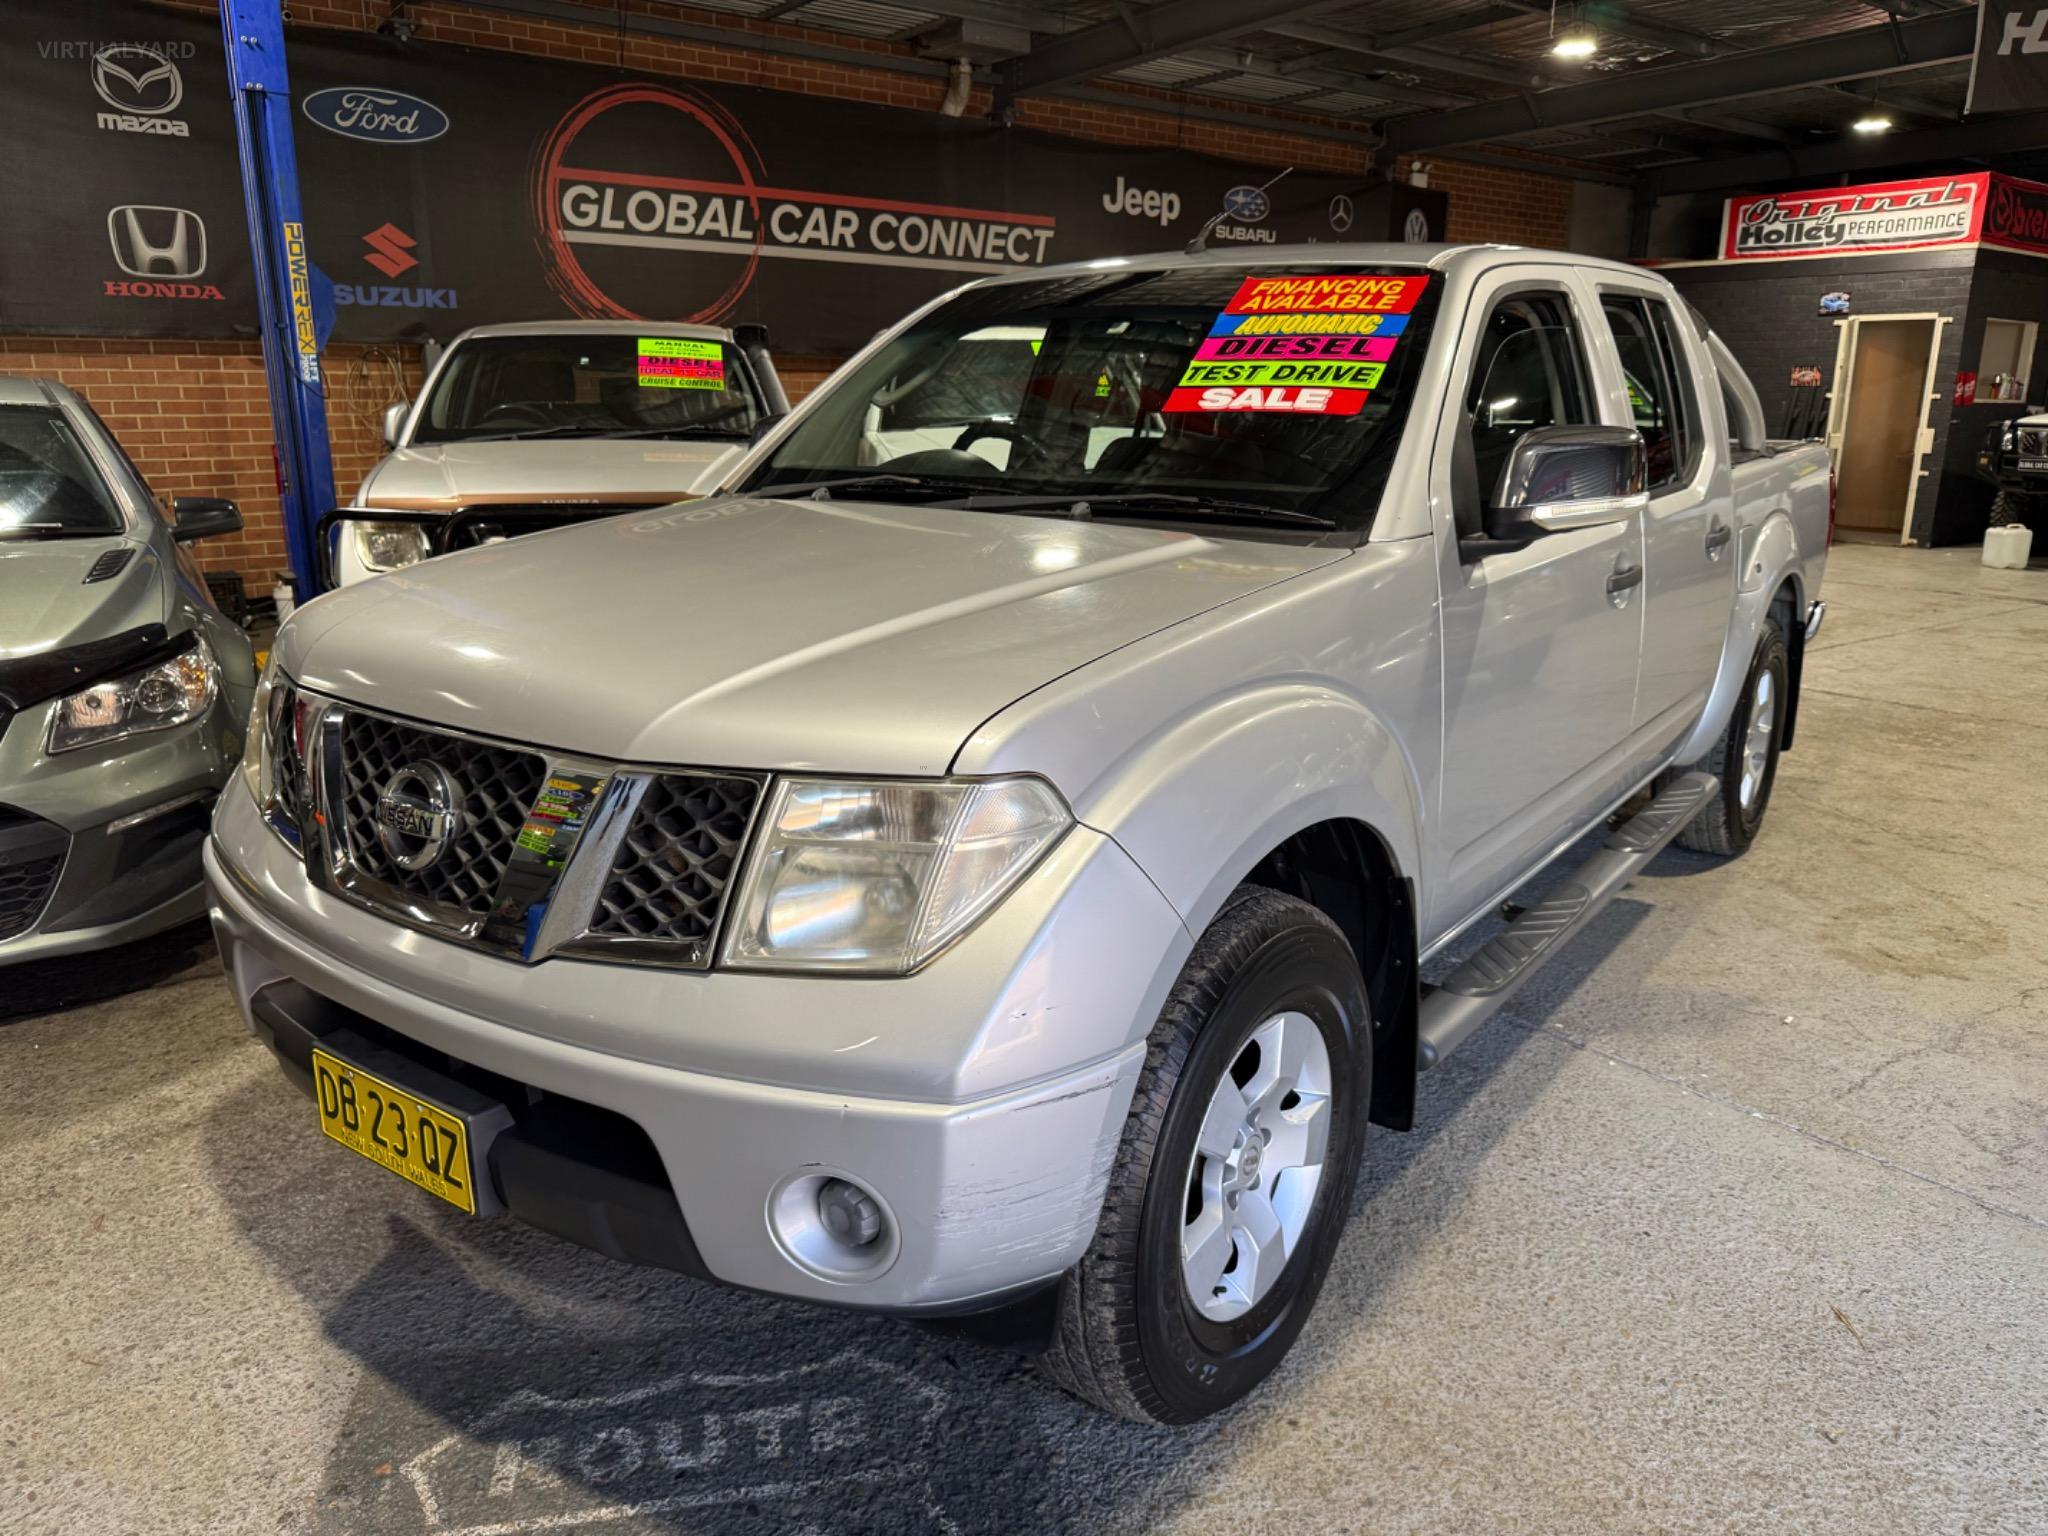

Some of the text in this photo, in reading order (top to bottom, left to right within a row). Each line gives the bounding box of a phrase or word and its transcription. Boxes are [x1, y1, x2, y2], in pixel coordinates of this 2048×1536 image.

[335, 93, 420, 134] Ford
[1103, 176, 1181, 226] Jeep
[1744, 181, 1966, 226] Original
[562, 185, 1055, 263] GLOBAL CAR CONNECT
[1215, 225, 1276, 243] SUBARU
[1738, 210, 1967, 246] Holley PERFORMANCE
[104, 281, 226, 300] HONDA
[333, 283, 458, 309] SUZUKI
[1251, 280, 1406, 295] FINANCING
[1240, 295, 1402, 310] AVAILABLE
[1233, 314, 1384, 335] AUTOMATIC
[1215, 338, 1373, 358] DIESEL
[1186, 364, 1378, 383] TEST DRIVE
[1197, 388, 1333, 411] SALE
